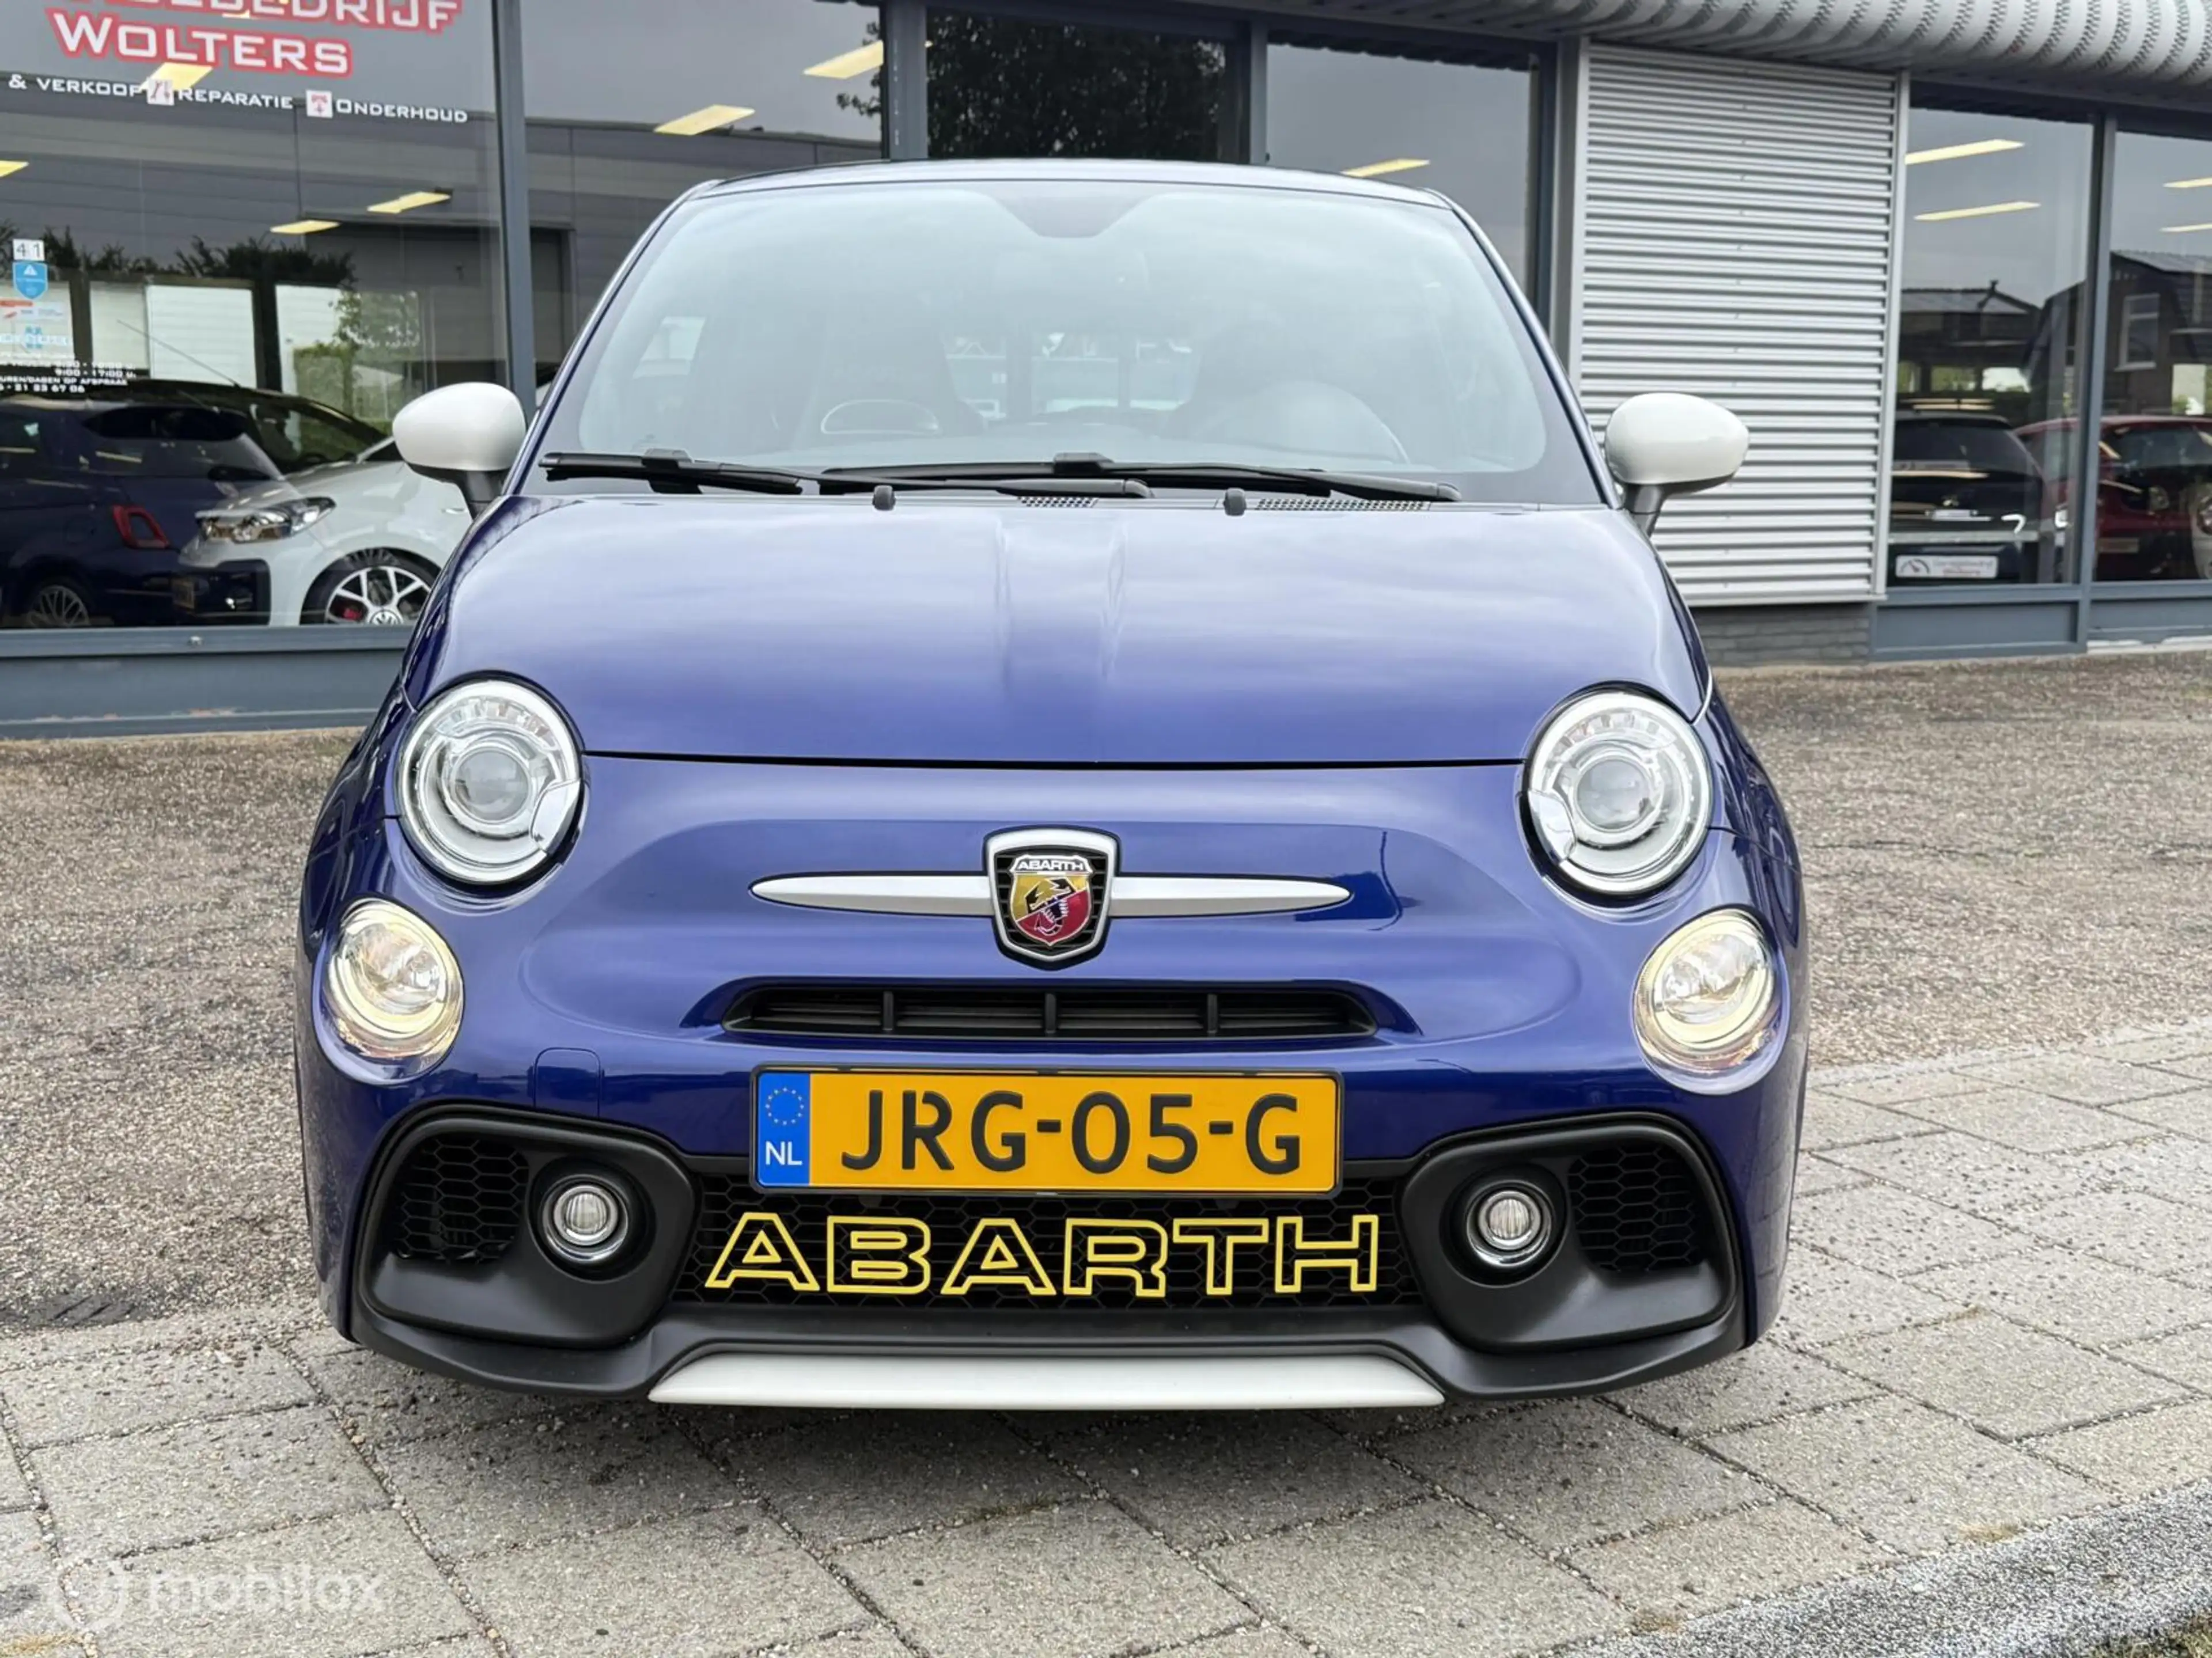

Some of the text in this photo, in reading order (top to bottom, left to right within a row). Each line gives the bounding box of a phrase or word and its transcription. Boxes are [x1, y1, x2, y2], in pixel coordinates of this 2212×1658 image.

[53, 13, 348, 73] WOLTERS
[9, 74, 468, 123] & VERKOOP REPARATIE ONDERHOUD
[16, 242, 41, 258] 41
[1018, 860, 1084, 871] ABARTH
[765, 1141, 802, 1166] NL
[841, 1090, 1301, 1175] JRG-05-G
[704, 1212, 1379, 1297] ABARTH
